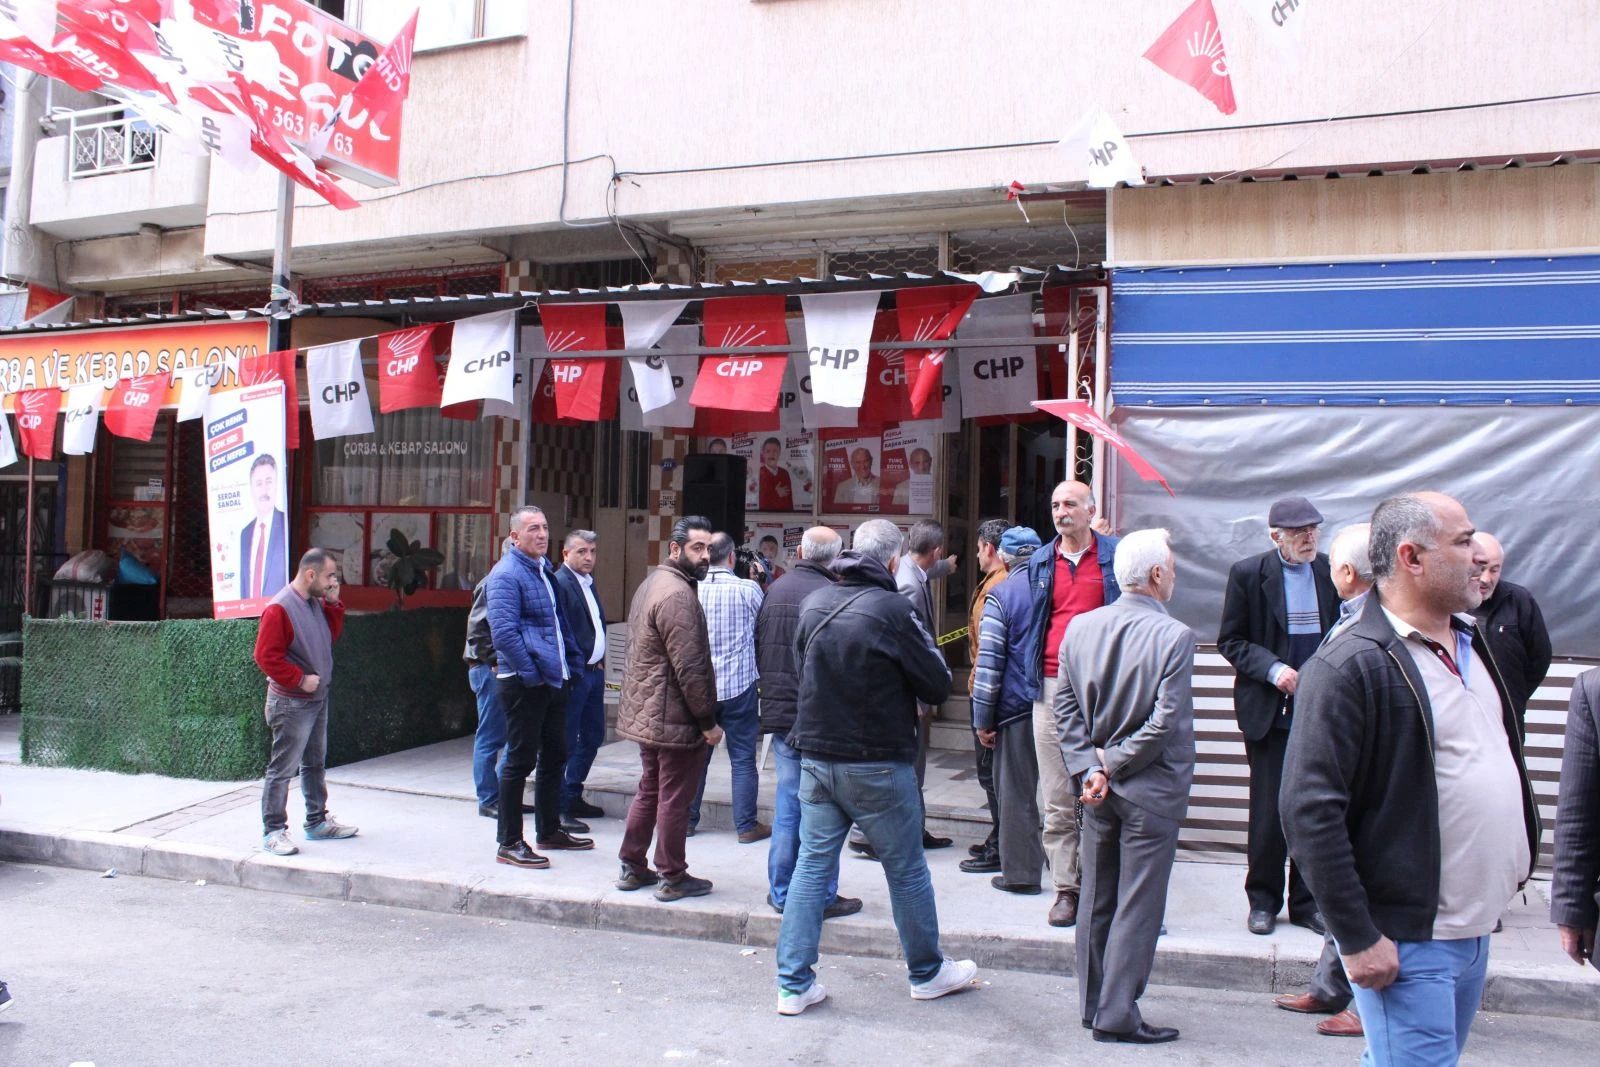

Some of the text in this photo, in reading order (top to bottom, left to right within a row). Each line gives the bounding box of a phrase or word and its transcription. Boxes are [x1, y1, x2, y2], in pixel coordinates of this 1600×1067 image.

[259, 3, 378, 82] FOTO
[202, 116, 221, 155] HP
[273, 106, 304, 135] 363
[334, 132, 353, 156] 63
[1088, 140, 1118, 167] HP
[387, 356, 419, 377] CHP
[464, 350, 511, 374] CHP
[716, 360, 763, 377] CHP
[809, 346, 860, 370] CHP
[973, 356, 1025, 380] CHP
[42, 349, 71, 392] VE
[75, 350, 151, 391] KEBAP
[553, 364, 582, 383] HP
[879, 369, 909, 386] CH
[124, 390, 150, 408] CHP
[322, 381, 361, 405] CHP
[20, 414, 42, 430] CHP
[344, 442, 377, 459] ÇORBA
[388, 441, 422, 456] KEBAP
[424, 441, 468, 455] SALONU
